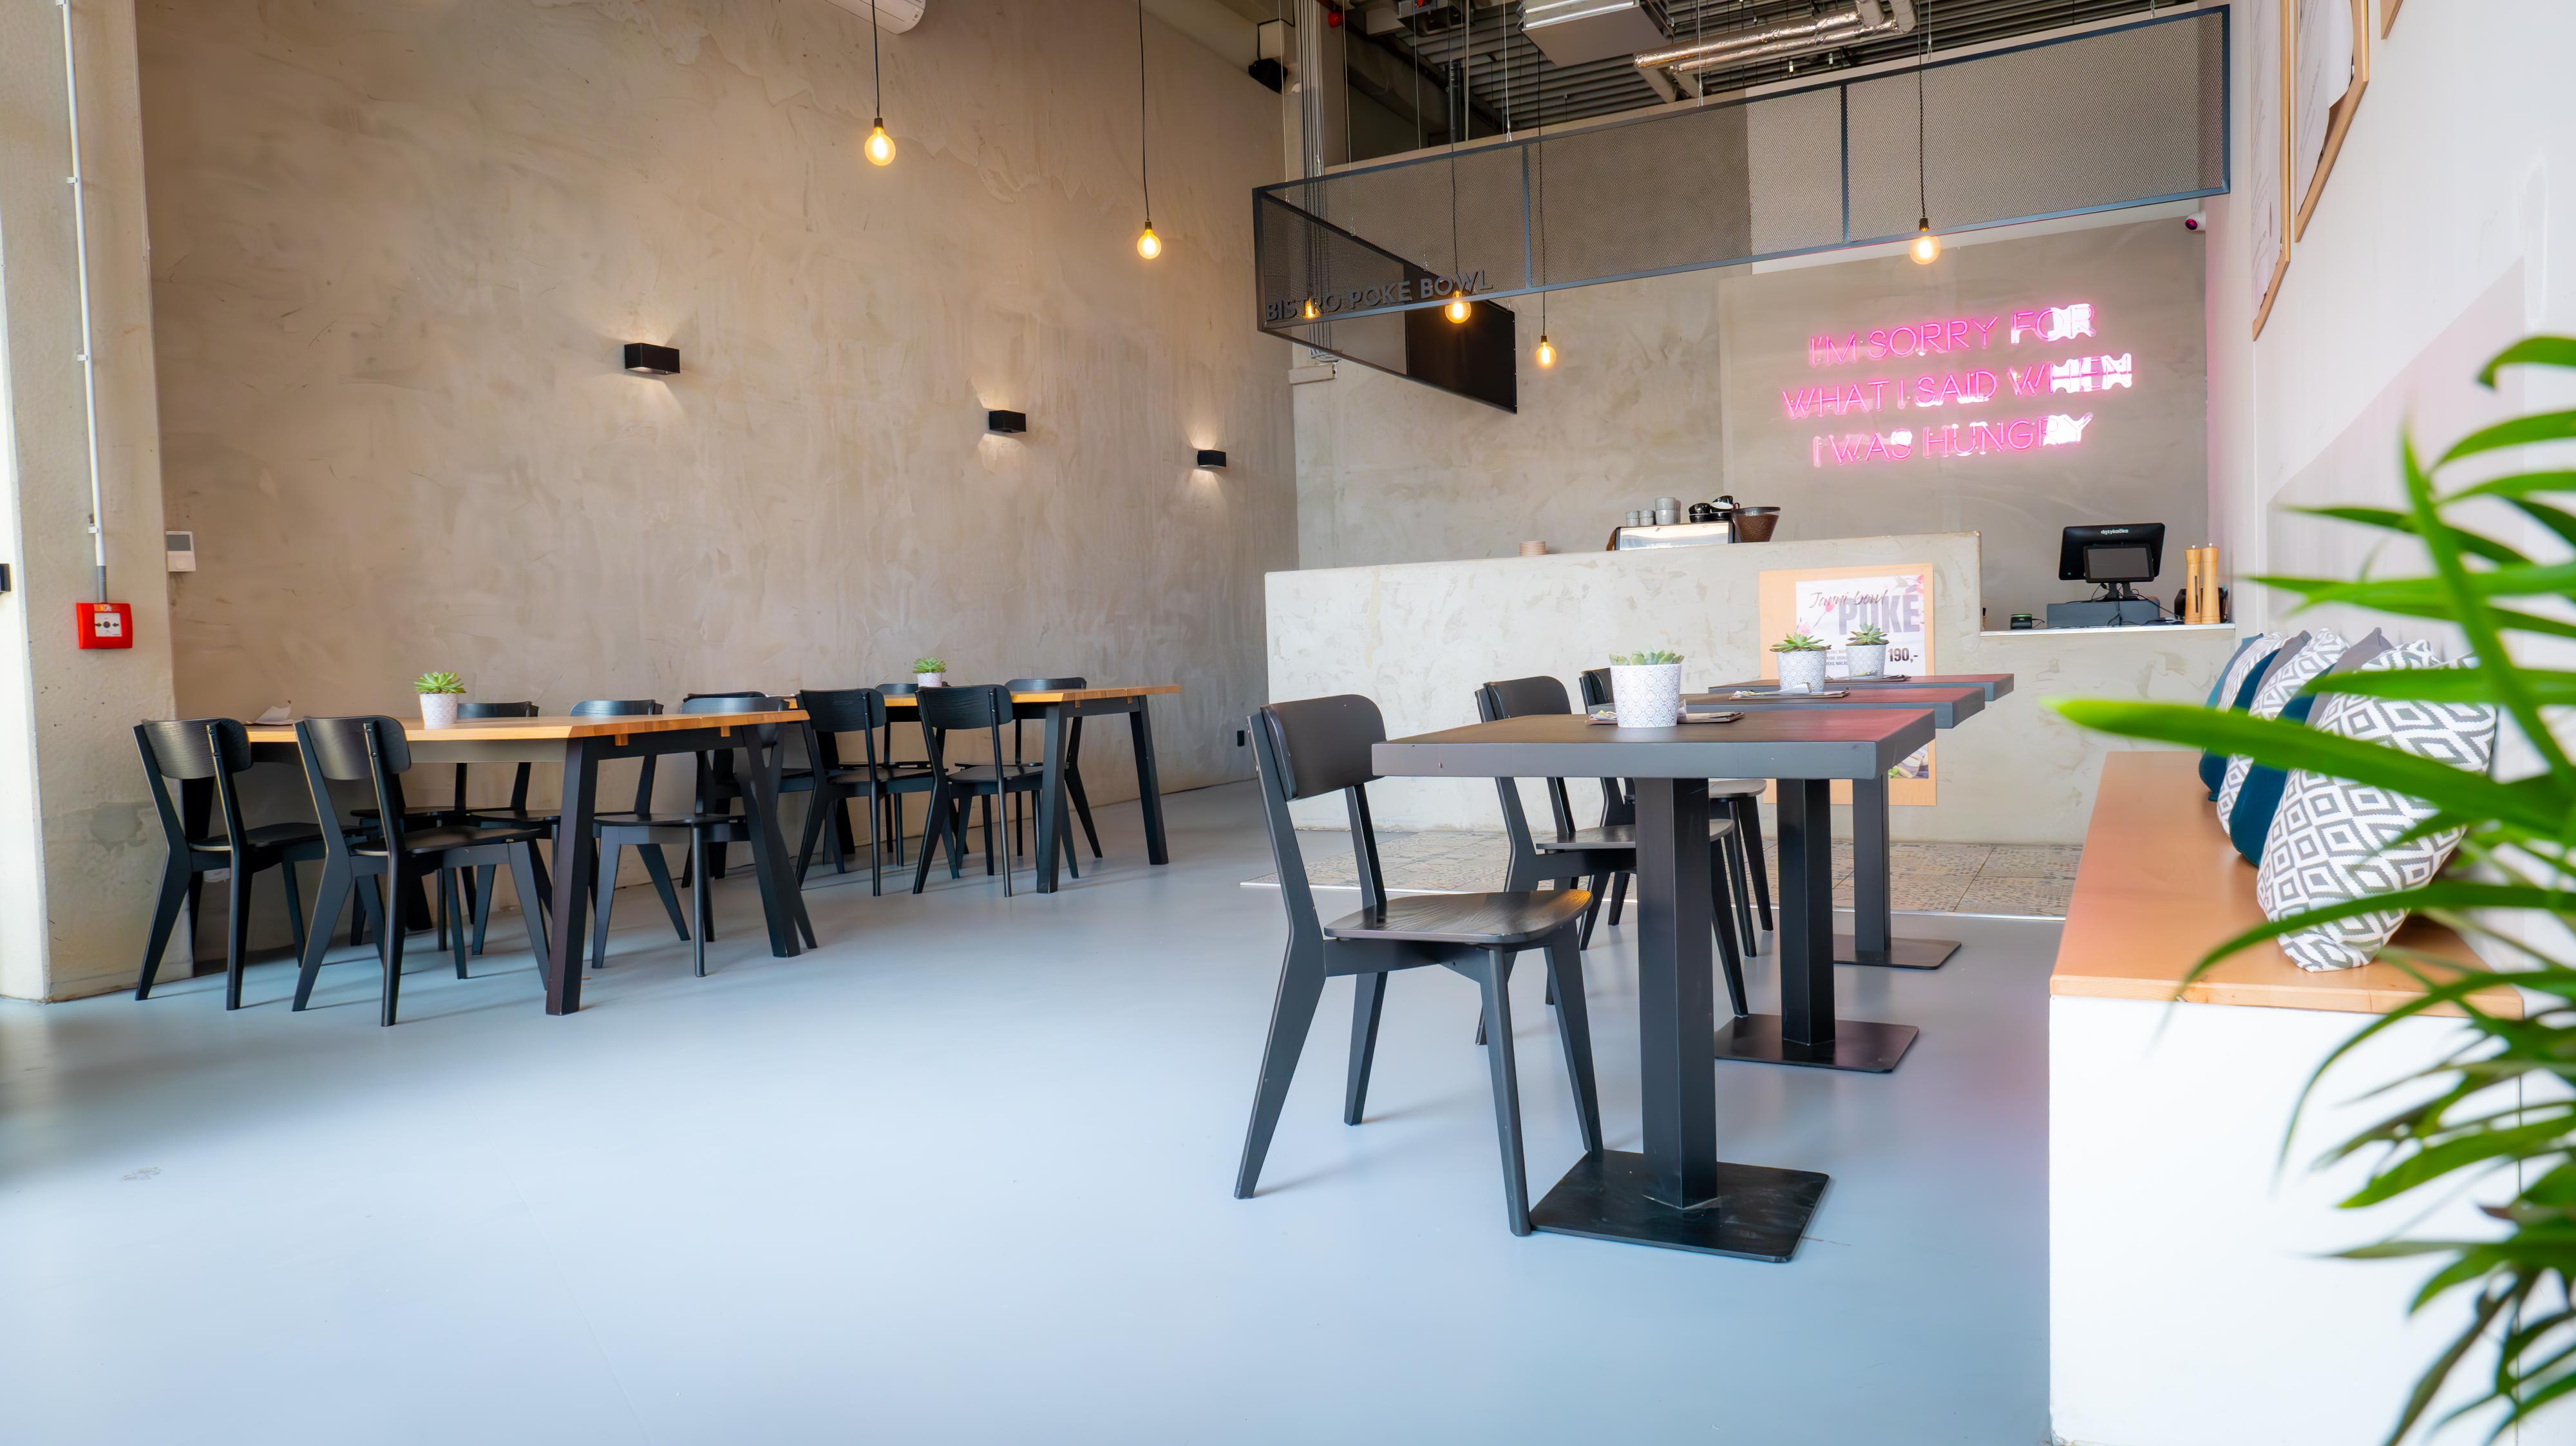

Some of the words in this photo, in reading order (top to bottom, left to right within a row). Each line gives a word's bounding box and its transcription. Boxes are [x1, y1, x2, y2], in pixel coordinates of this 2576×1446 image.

[1349, 280, 1413, 310] POKE
[1420, 269, 1494, 298] BOWL
[1810, 332, 1857, 366] I'M
[1868, 316, 1998, 360] SORRY
[2011, 303, 2096, 344] FOR
[1782, 380, 1889, 419] WHAT
[1897, 379, 1906, 409] I
[1915, 370, 1998, 406] SAID
[2007, 352, 2132, 395] WHEN
[1813, 435, 1822, 468] I
[1829, 429, 1913, 465] WAS
[1923, 412, 2094, 458] HUNGRY
[1888, 647, 1918, 663] 190,-
